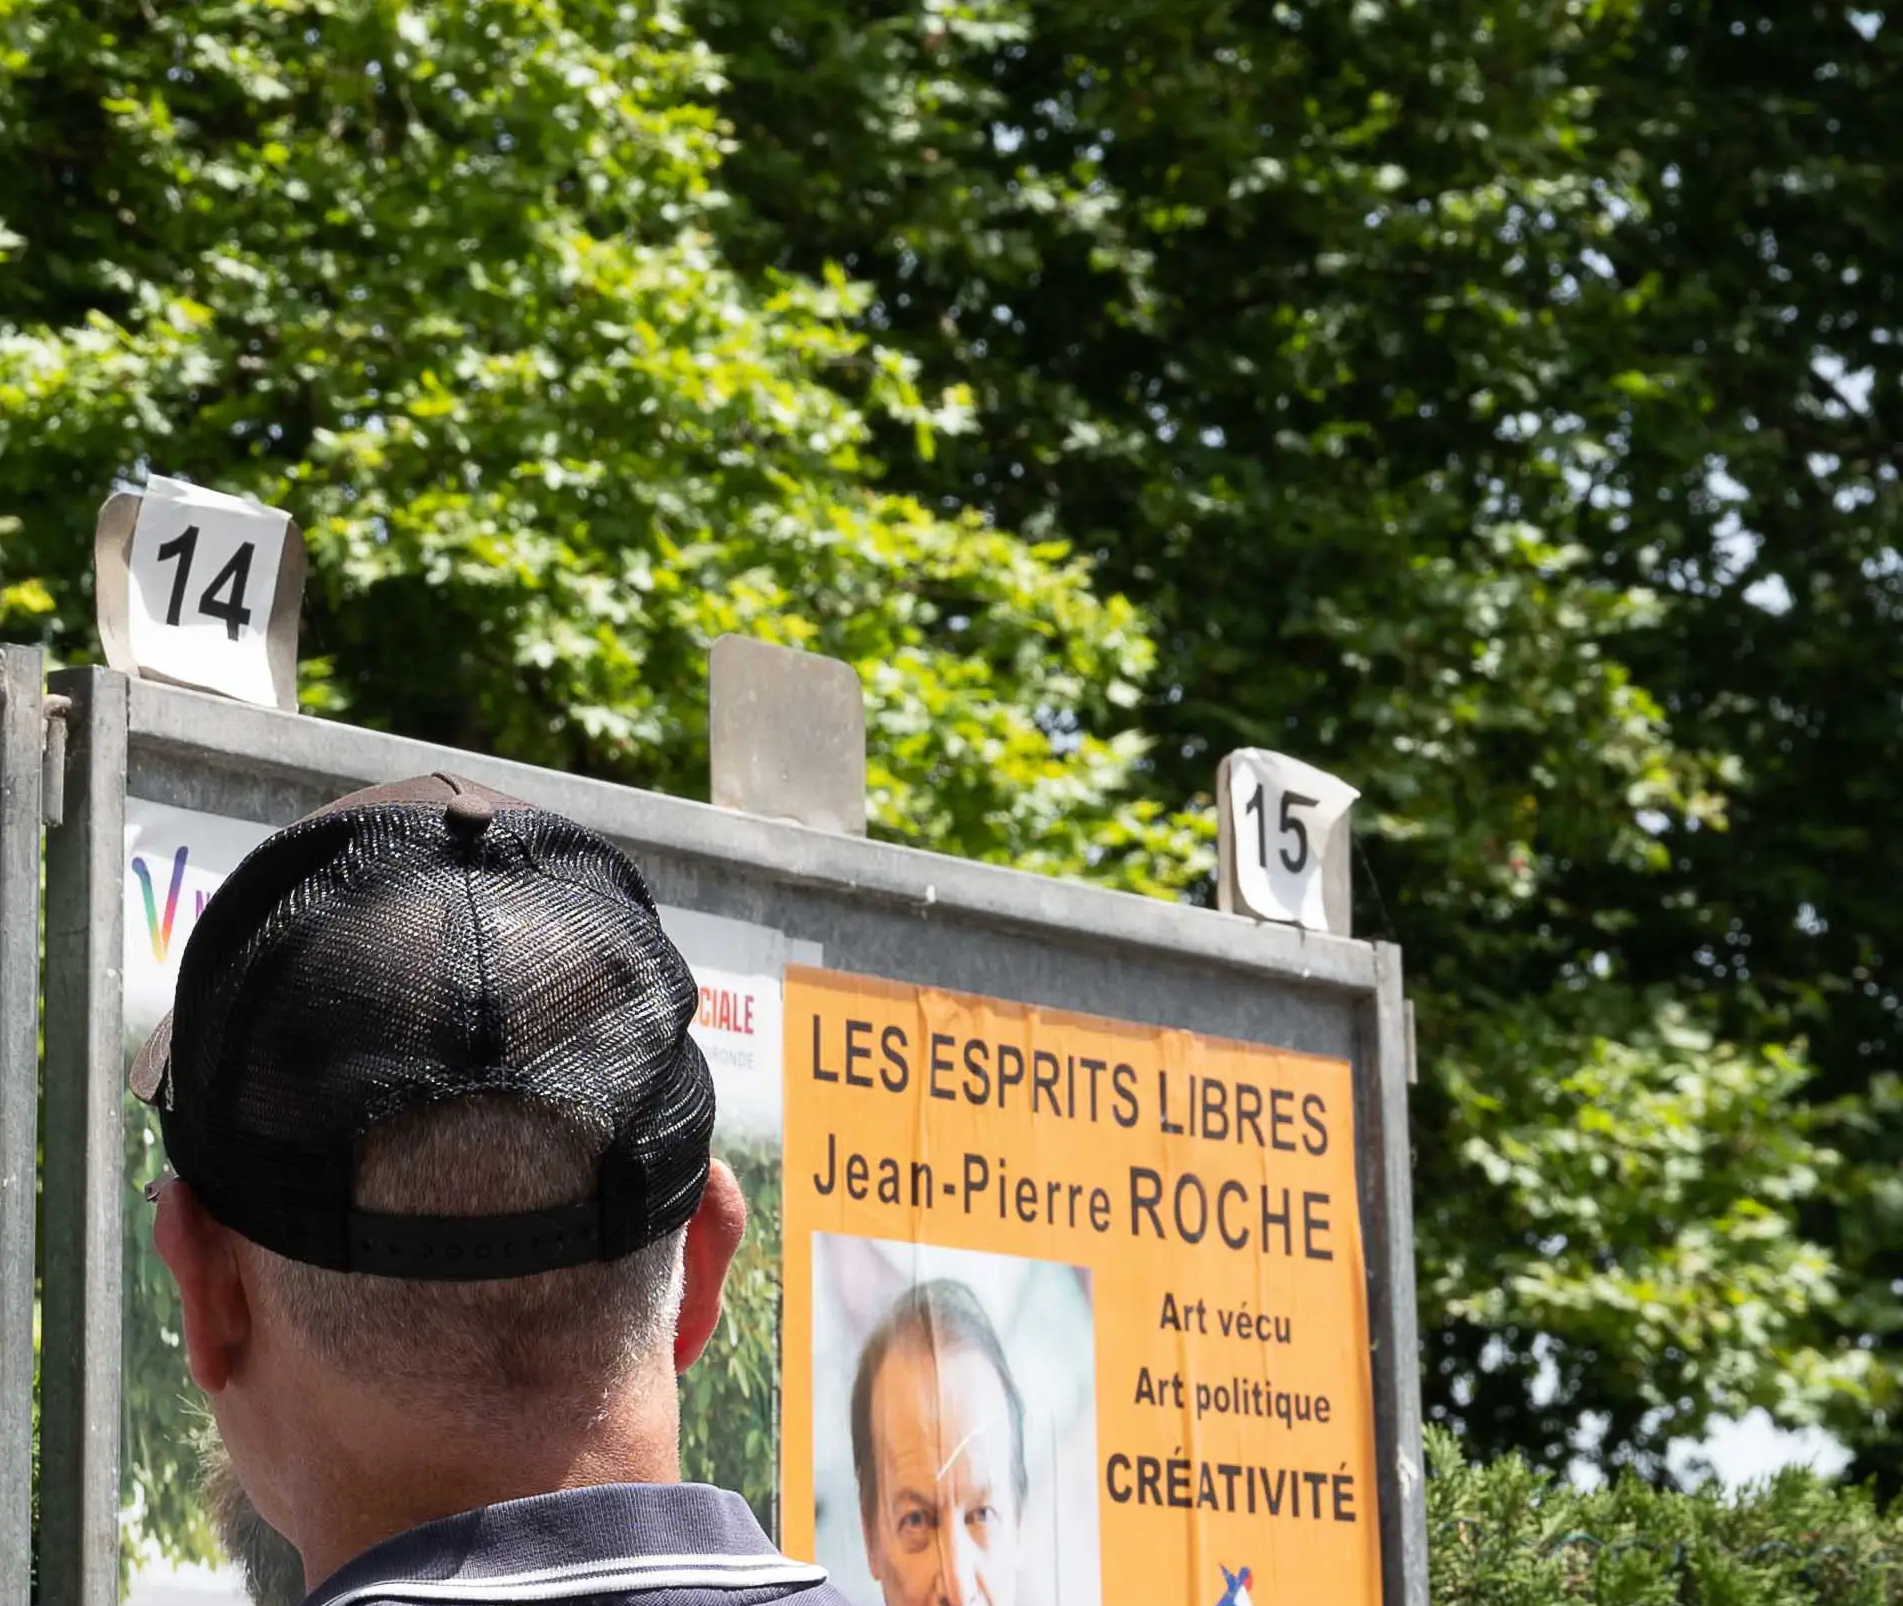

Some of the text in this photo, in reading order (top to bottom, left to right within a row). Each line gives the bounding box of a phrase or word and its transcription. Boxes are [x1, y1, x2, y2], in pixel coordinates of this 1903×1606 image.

[157, 526, 254, 640] 14
[1247, 783, 1318, 874] 15
[691, 986, 754, 1035] CIALE
[813, 1015, 1327, 1156] LES ESPRITS LIBRES
[814, 1134, 1333, 1261] Jean-Pierre ROCHE
[1160, 1293, 1291, 1343] Art vécu
[1135, 1367, 1330, 1428] Art politique
[1107, 1447, 1356, 1522] CRÉATIVITÉ
